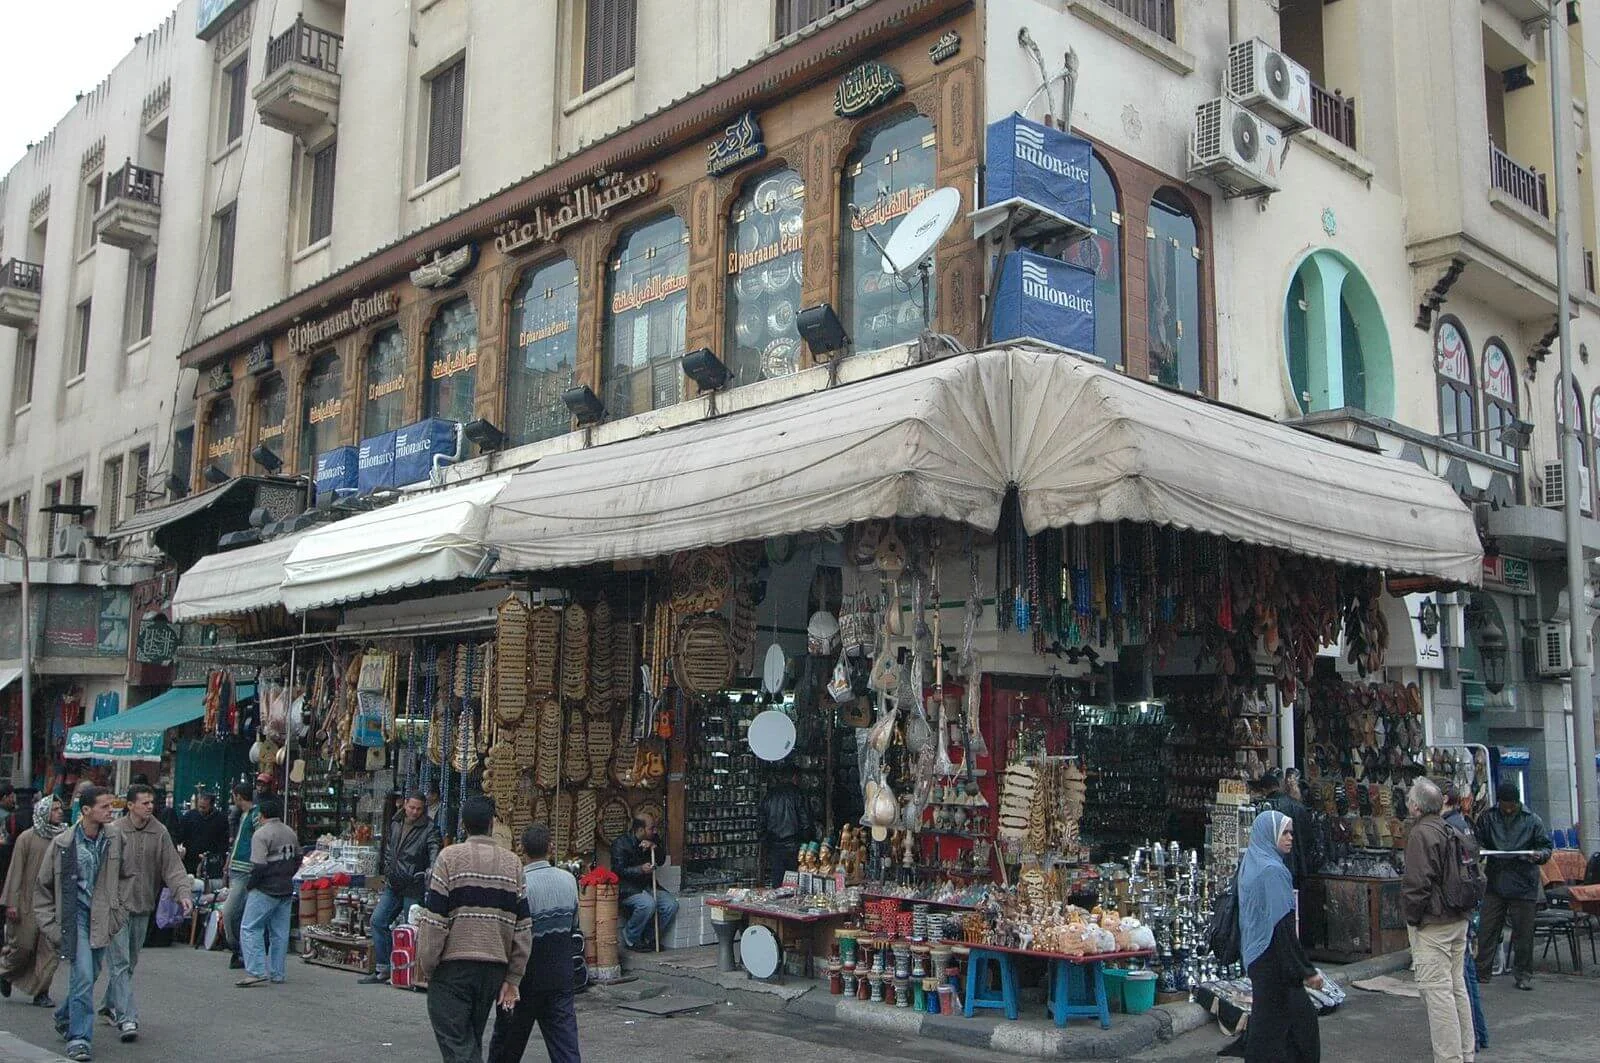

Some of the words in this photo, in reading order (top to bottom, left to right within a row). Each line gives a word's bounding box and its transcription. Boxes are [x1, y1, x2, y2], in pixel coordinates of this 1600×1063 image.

[1015, 142, 1090, 184] unionaire
[494, 184, 593, 254] الفراعنة
[728, 252, 739, 275] El
[738, 241, 779, 273] pharaana
[780, 231, 803, 255] Cent
[350, 290, 391, 327] Center
[1022, 278, 1093, 315] unionaire
